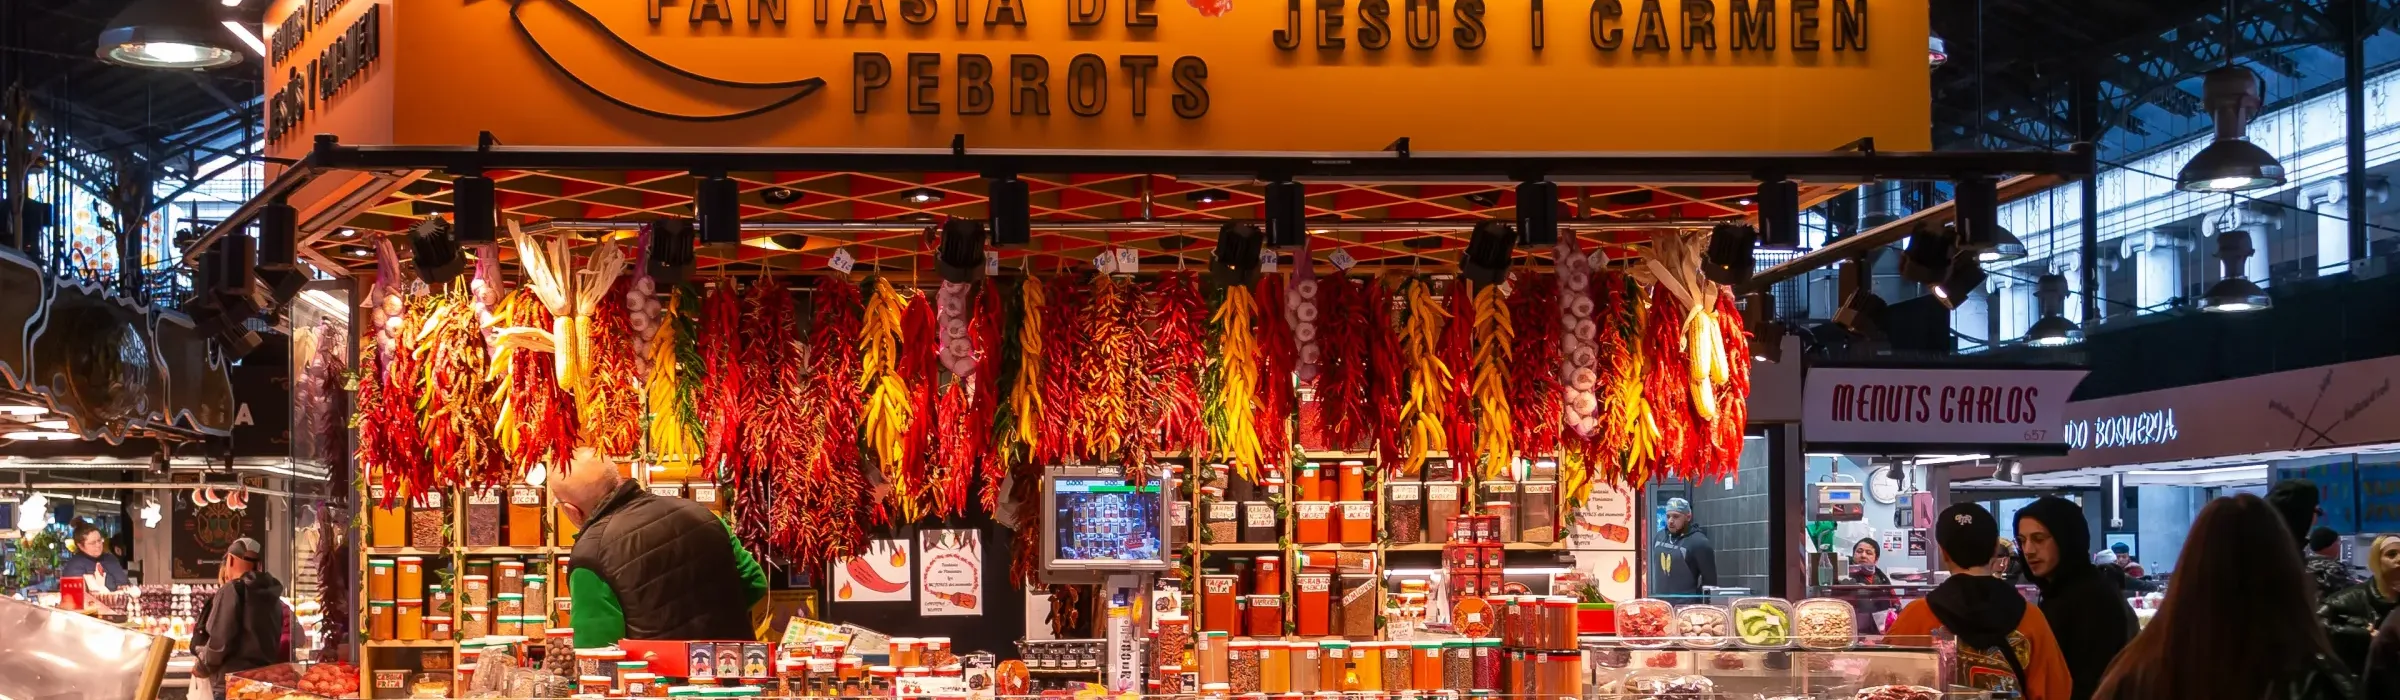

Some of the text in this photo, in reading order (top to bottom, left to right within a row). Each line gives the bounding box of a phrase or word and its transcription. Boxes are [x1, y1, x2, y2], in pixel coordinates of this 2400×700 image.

[319, 2, 380, 101] CARMEN
[1530, 0, 1545, 51] I
[1588, 0, 1869, 52] CARMEN
[852, 51, 1211, 120] PEBROTS
[1831, 383, 2039, 425] MENUTS CARLOS
[2023, 429, 2046, 442] 657
